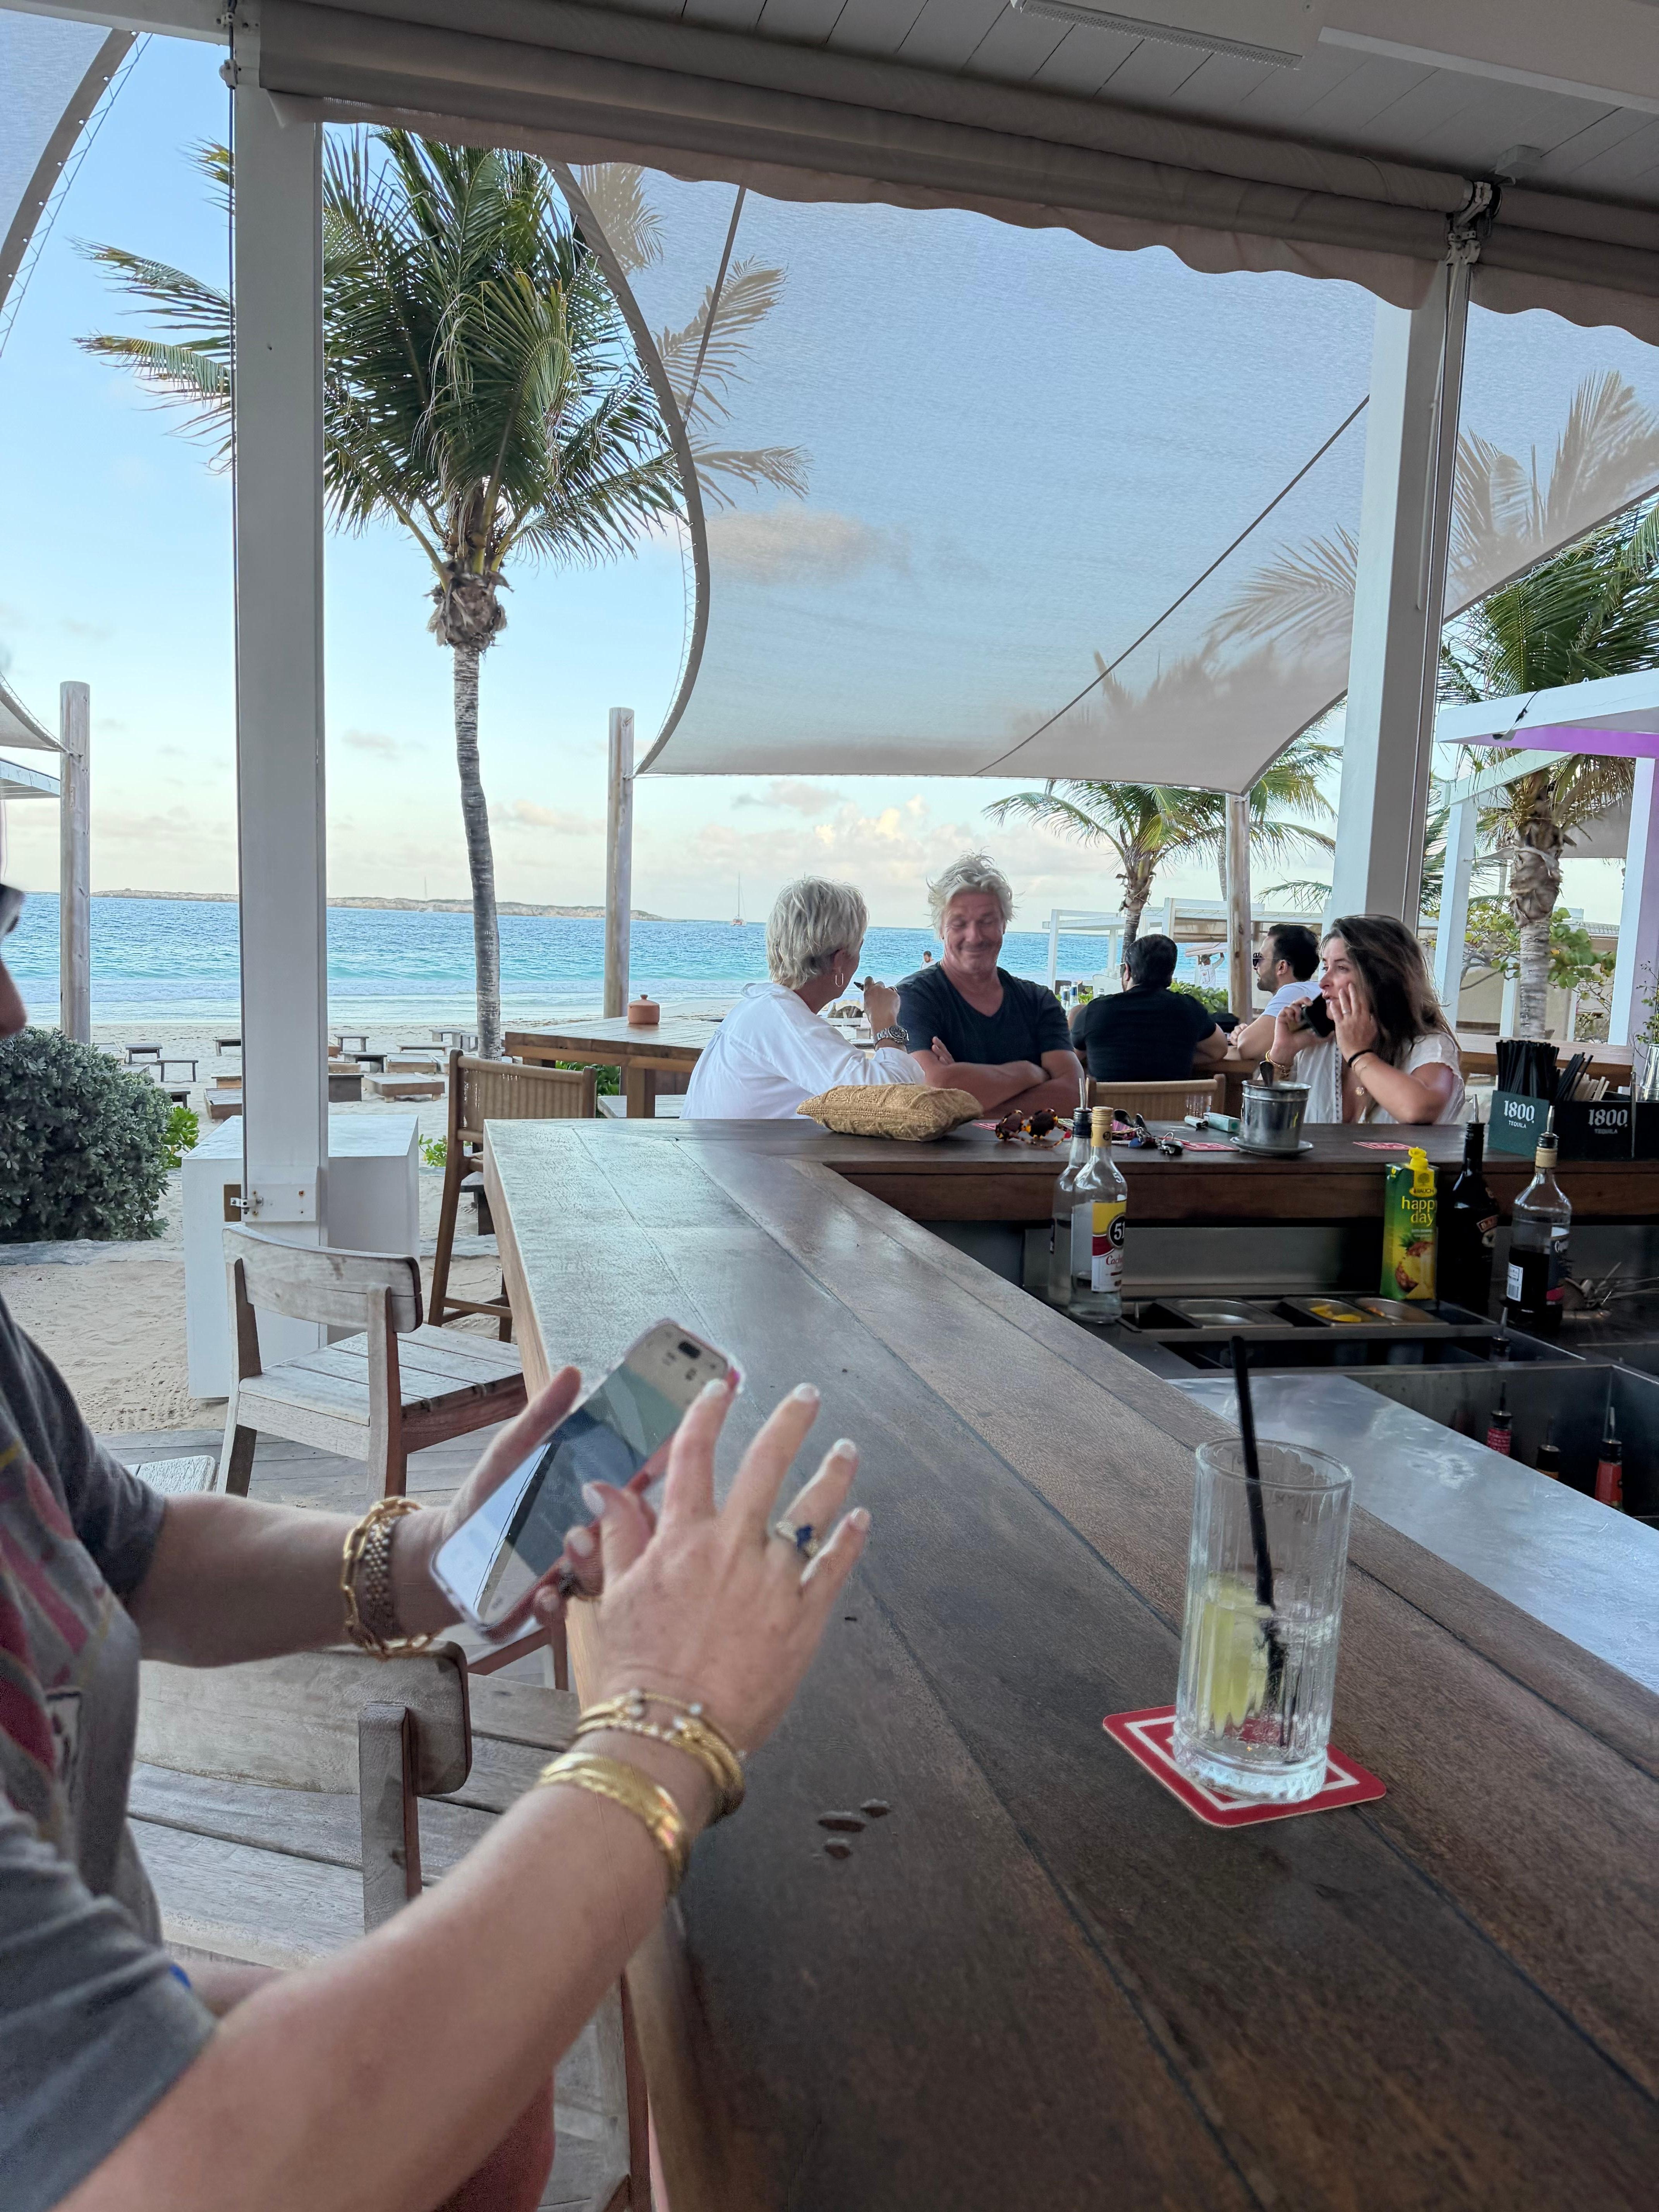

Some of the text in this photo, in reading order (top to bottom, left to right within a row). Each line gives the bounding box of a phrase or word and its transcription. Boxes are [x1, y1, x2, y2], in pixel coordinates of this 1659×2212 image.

[1509, 1120, 1526, 1128] TEQUILA
[1410, 1211, 1433, 1226] day
[1114, 1221, 1125, 1240] 51
